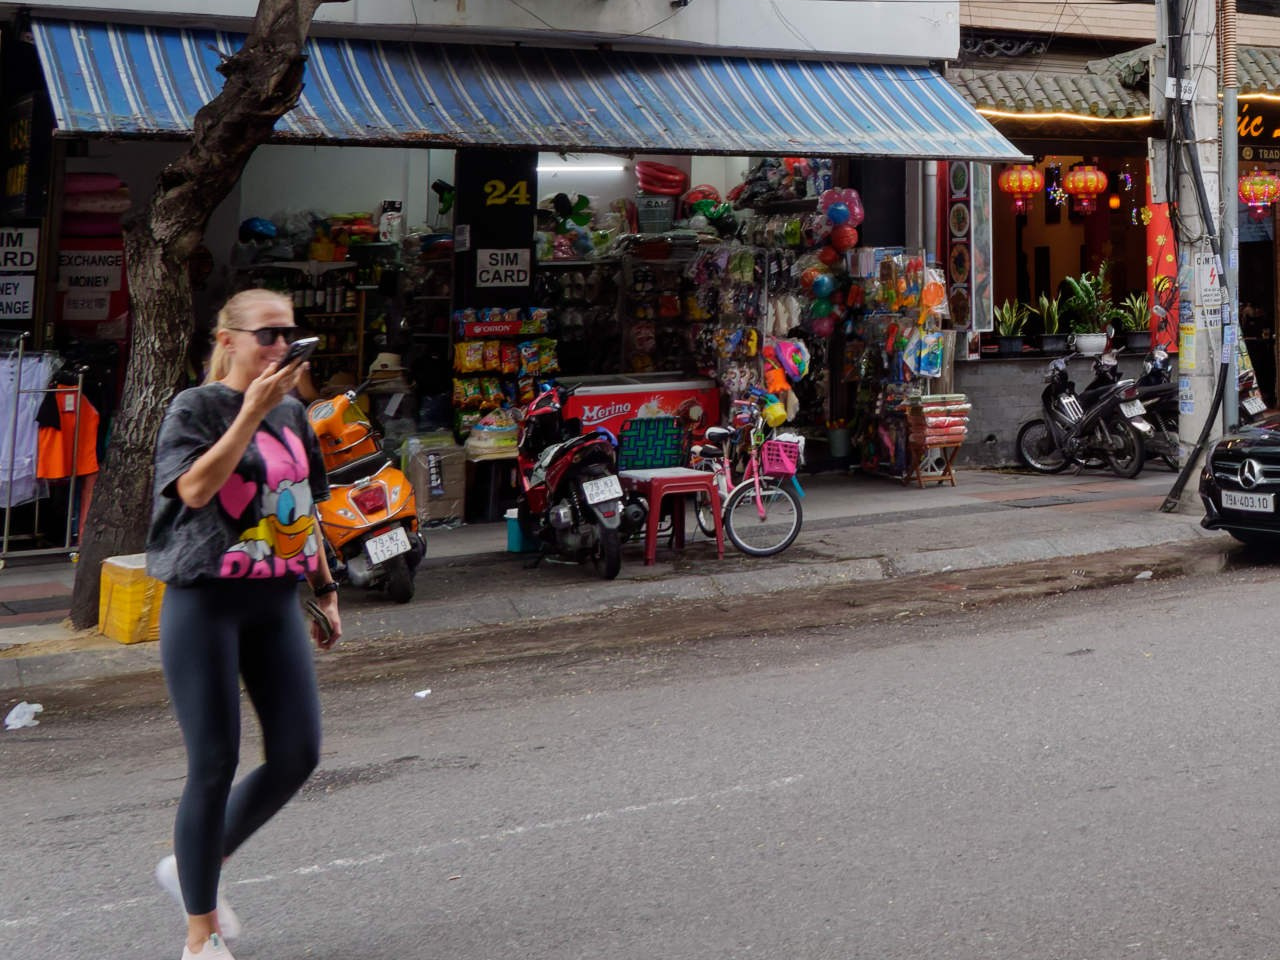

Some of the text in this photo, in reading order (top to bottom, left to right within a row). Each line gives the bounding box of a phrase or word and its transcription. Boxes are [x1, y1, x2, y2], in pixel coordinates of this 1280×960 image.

[1237, 104, 1264, 137] úc
[484, 180, 531, 206] 24
[0, 232, 23, 247] IM
[59, 255, 122, 267] EXCHANGE
[488, 253, 519, 266] SIM
[68, 276, 110, 288] MONEY
[479, 270, 528, 283] CARD
[0, 283, 19, 295] NEY
[0, 301, 29, 313] ANGE
[582, 402, 631, 420] Merino
